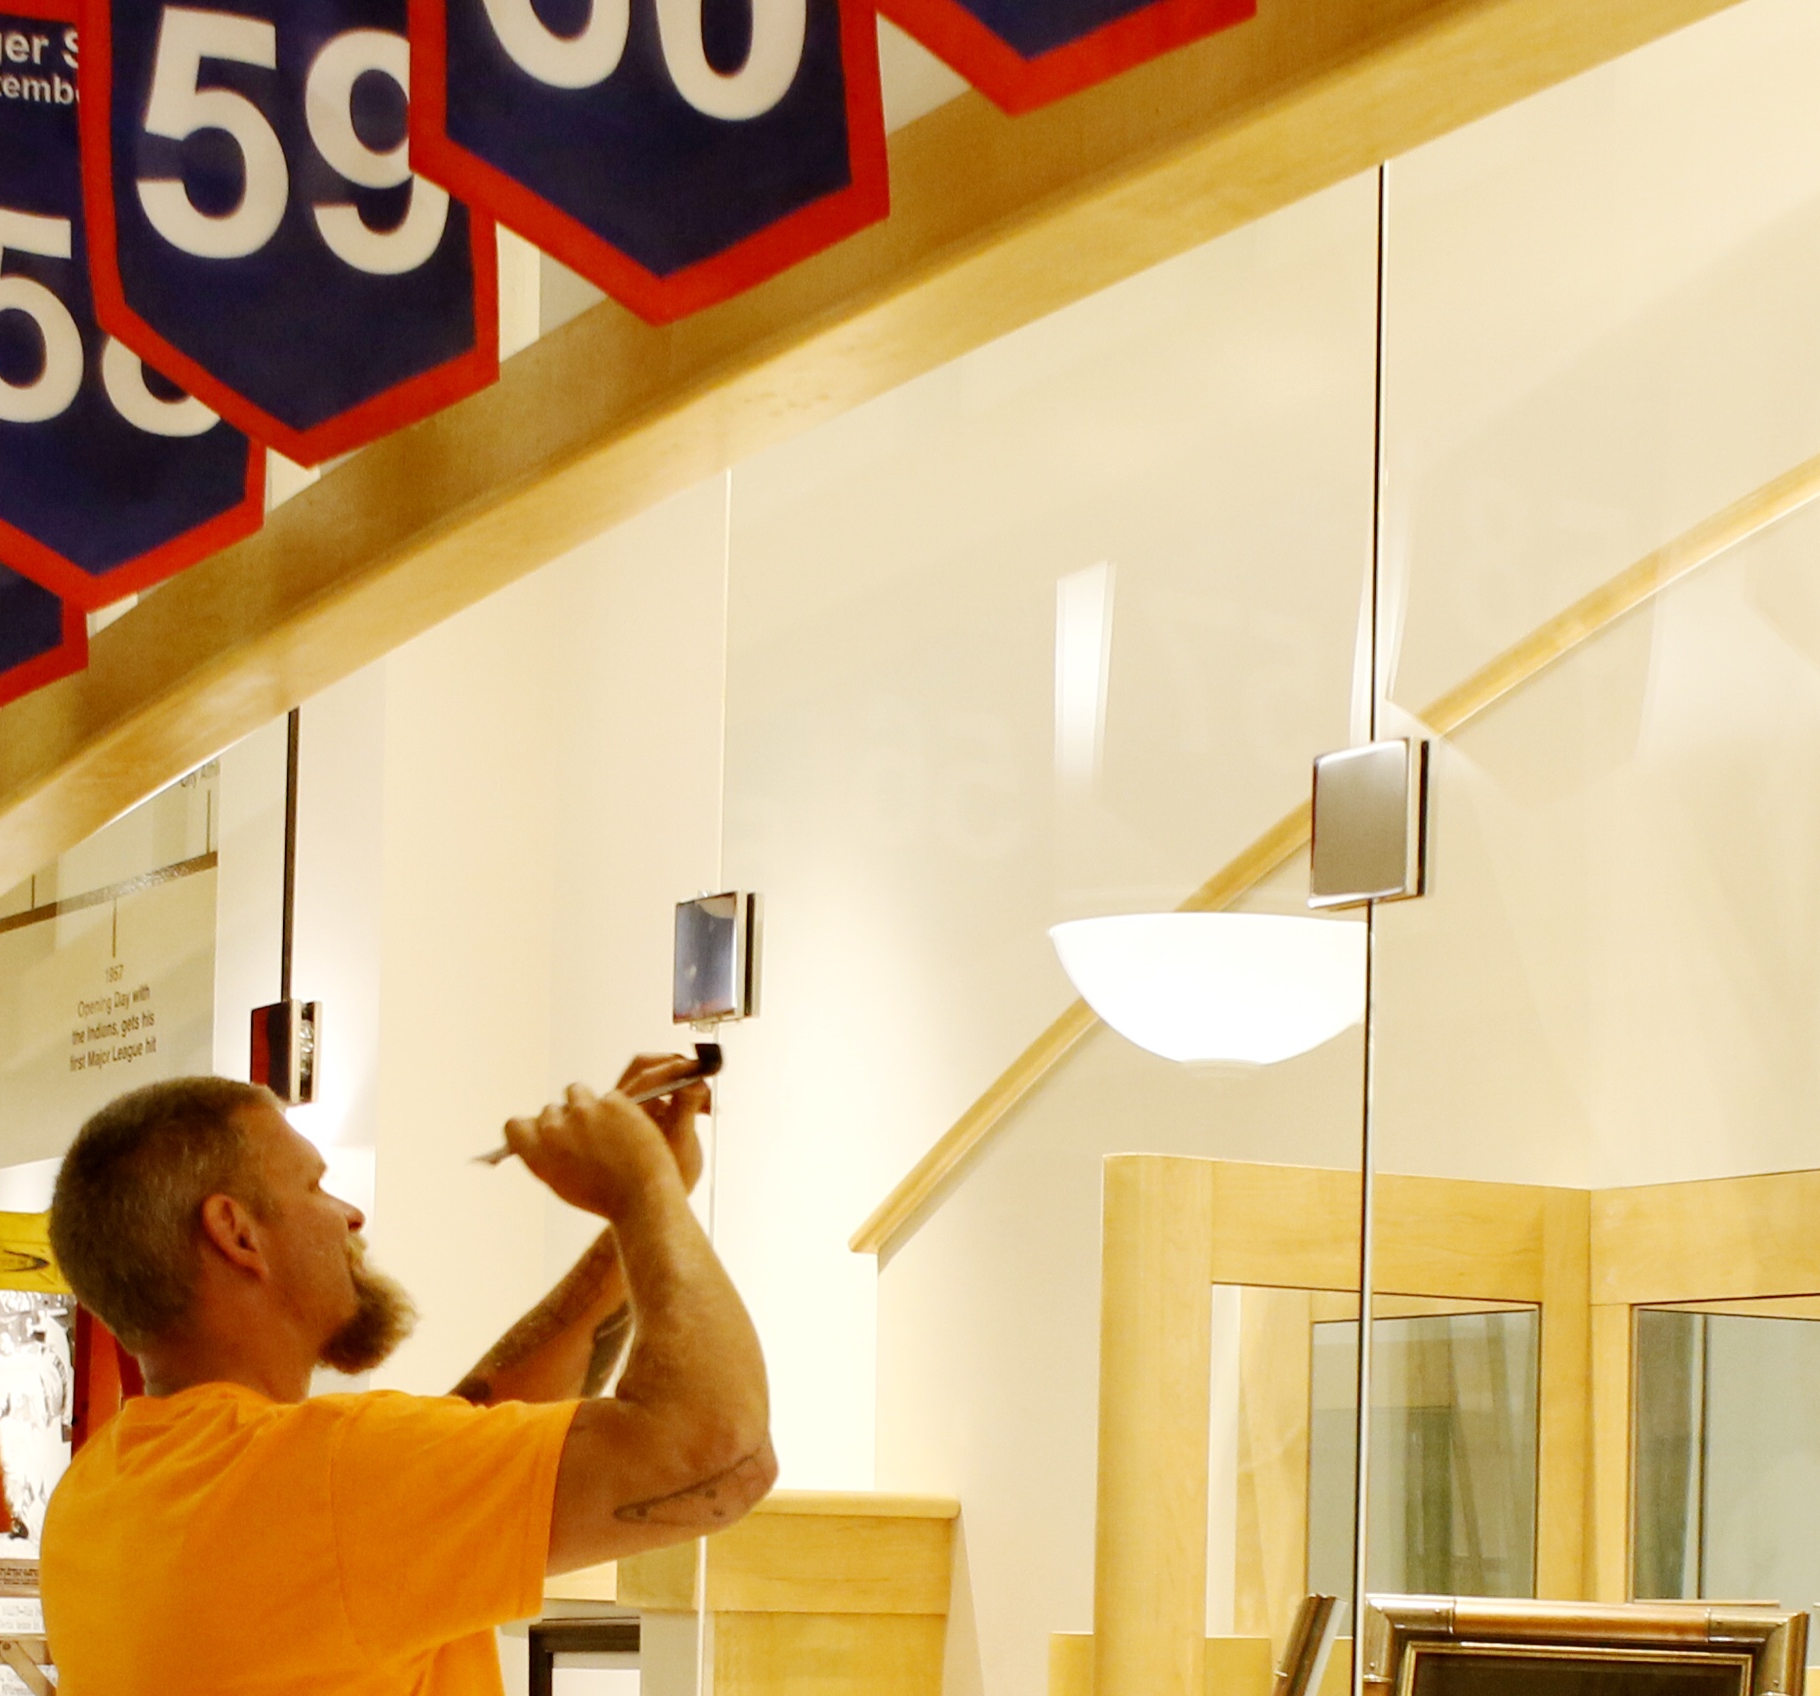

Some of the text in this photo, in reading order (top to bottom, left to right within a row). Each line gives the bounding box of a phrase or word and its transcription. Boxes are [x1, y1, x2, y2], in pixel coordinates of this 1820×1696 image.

[135, 6, 449, 276] 59
[114, 991, 131, 1010] Day
[113, 1042, 143, 1063] League
